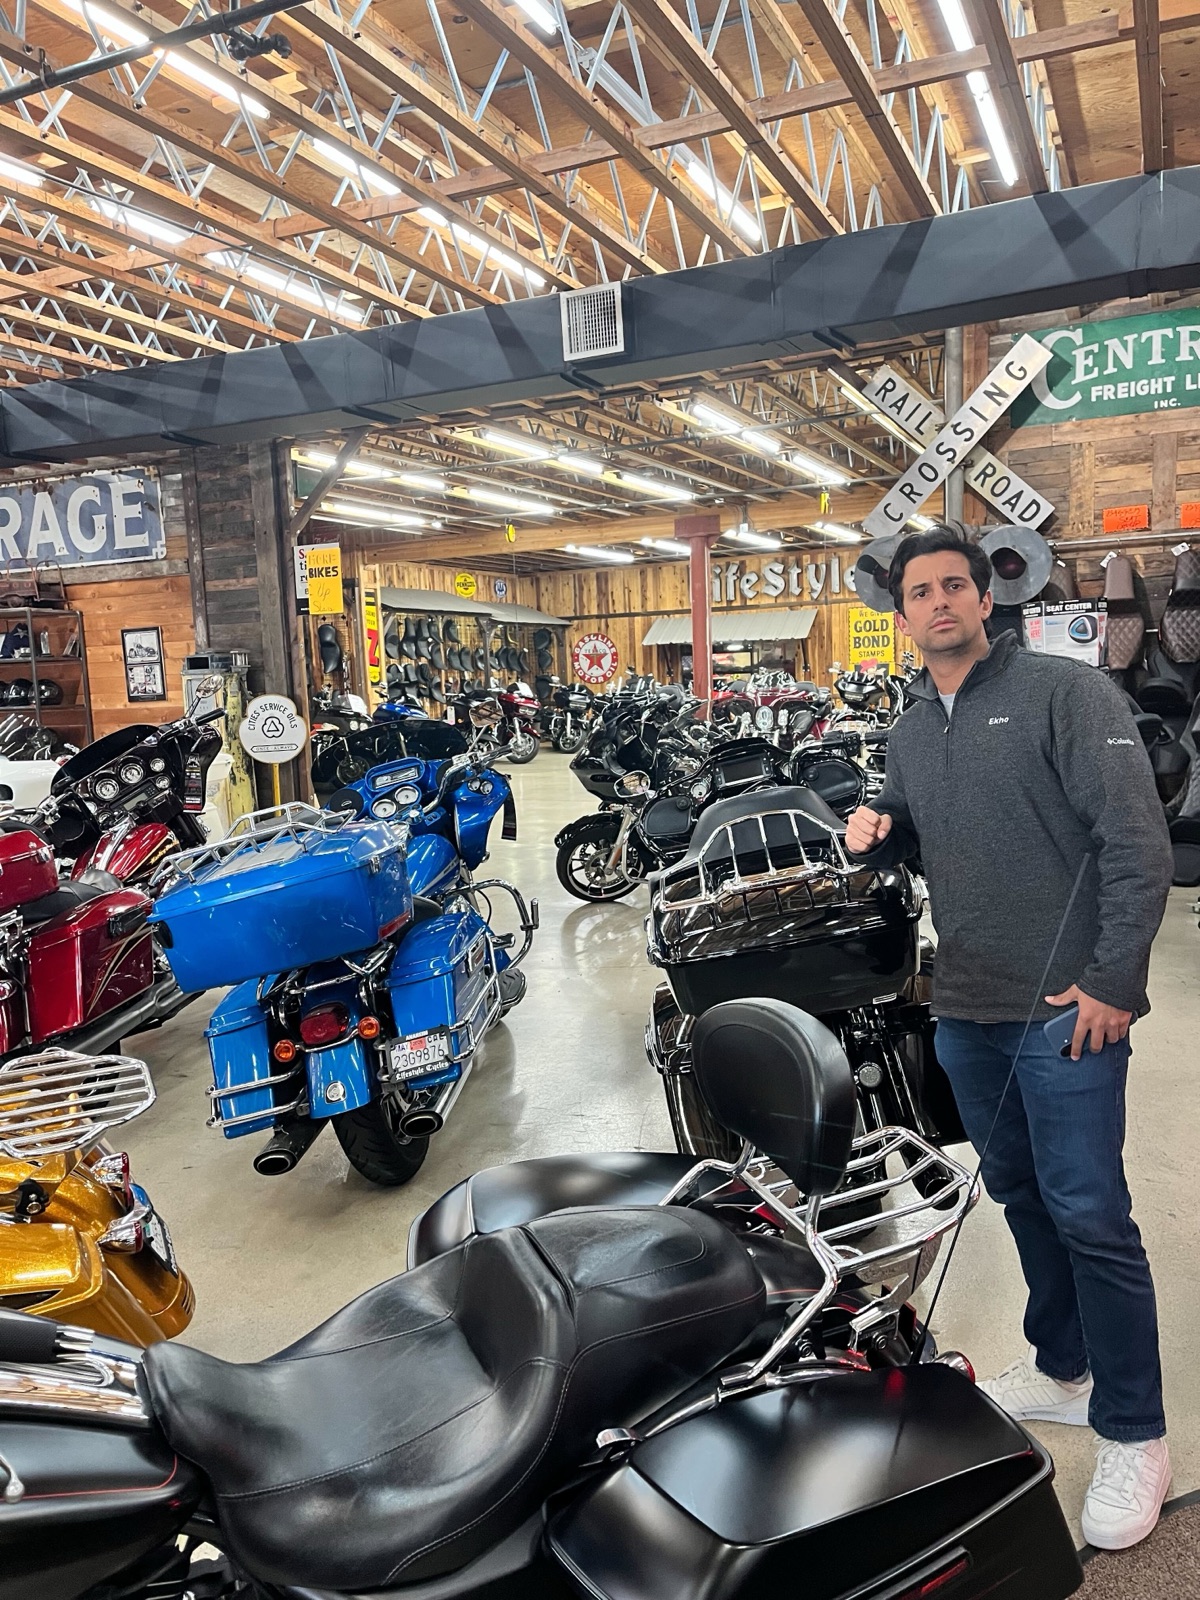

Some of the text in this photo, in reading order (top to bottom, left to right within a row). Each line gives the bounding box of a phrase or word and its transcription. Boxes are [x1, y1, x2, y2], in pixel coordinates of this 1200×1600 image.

[1090, 375, 1176, 402] FREIGHT
[1153, 397, 1181, 409] INC.
[875, 376, 1041, 523] RAIL ROAD
[883, 360, 1028, 523] CROSSING
[0, 478, 150, 562] RAGE
[308, 566, 339, 579] BIKES
[712, 555, 857, 602] ifeStyle
[1045, 604, 1064, 613] SEAT
[1064, 602, 1092, 611] CENTER
[853, 619, 890, 633] GOLD
[574, 634, 617, 654] GASOLINE
[853, 634, 891, 649] BOND
[858, 650, 885, 658] STAMPS
[573, 661, 618, 683] MOTOR OIL
[247, 702, 298, 731] CITIES SERVICE OILS
[988, 716, 1009, 725] Ekho
[393, 1044, 445, 1069] 23G9876
[425, 1061, 449, 1072] Cycles
